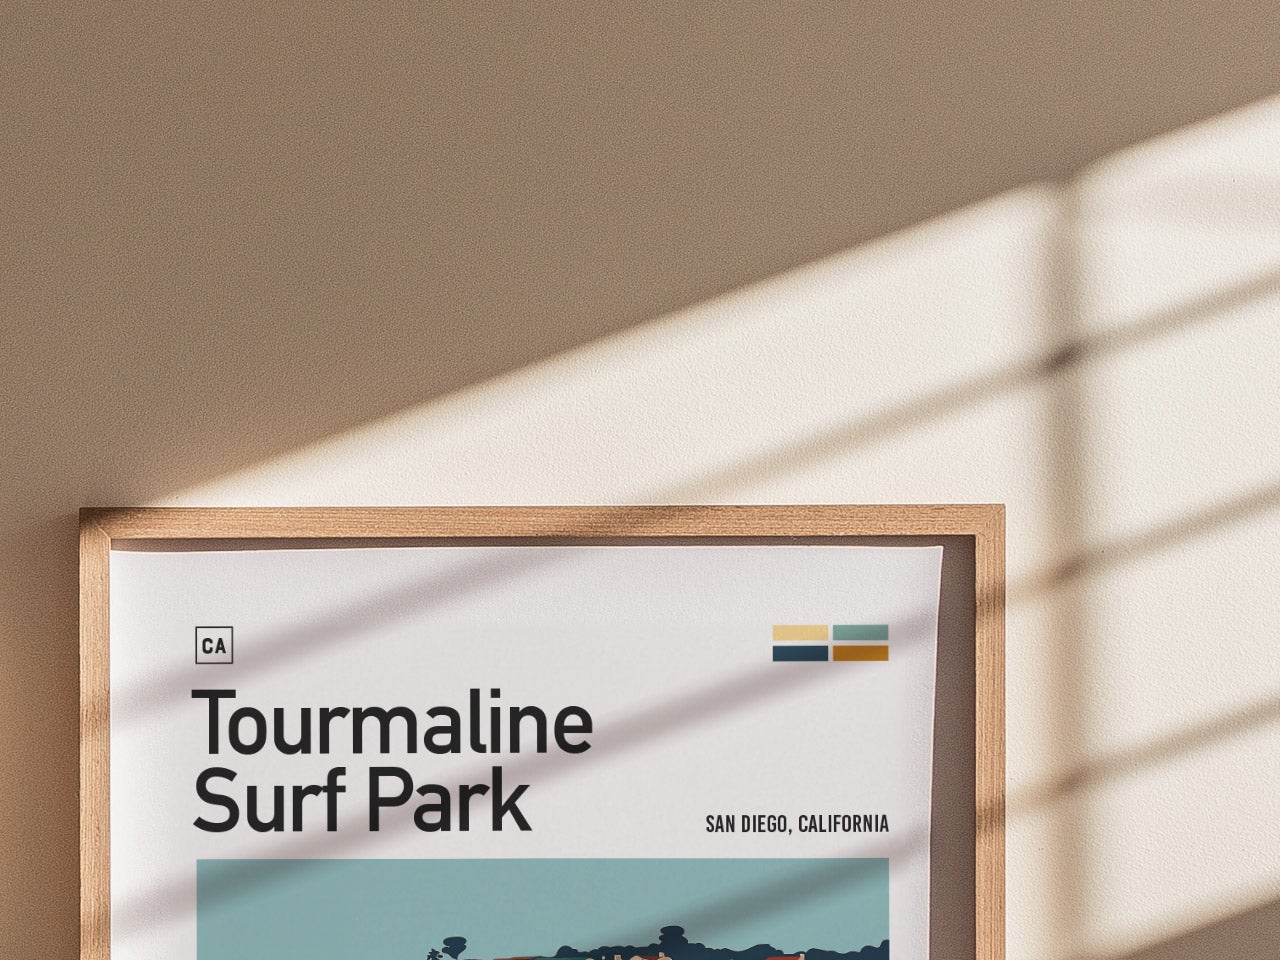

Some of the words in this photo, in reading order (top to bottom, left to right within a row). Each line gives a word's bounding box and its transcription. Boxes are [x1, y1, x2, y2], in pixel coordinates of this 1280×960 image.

[202, 638, 226, 654] CA
[191, 688, 592, 755] Tourmaline
[193, 767, 346, 832] Surf
[369, 766, 532, 832] Park
[706, 815, 735, 832] SAN
[742, 815, 792, 835] DIEGO,
[799, 815, 889, 832] CALIFORNIA
